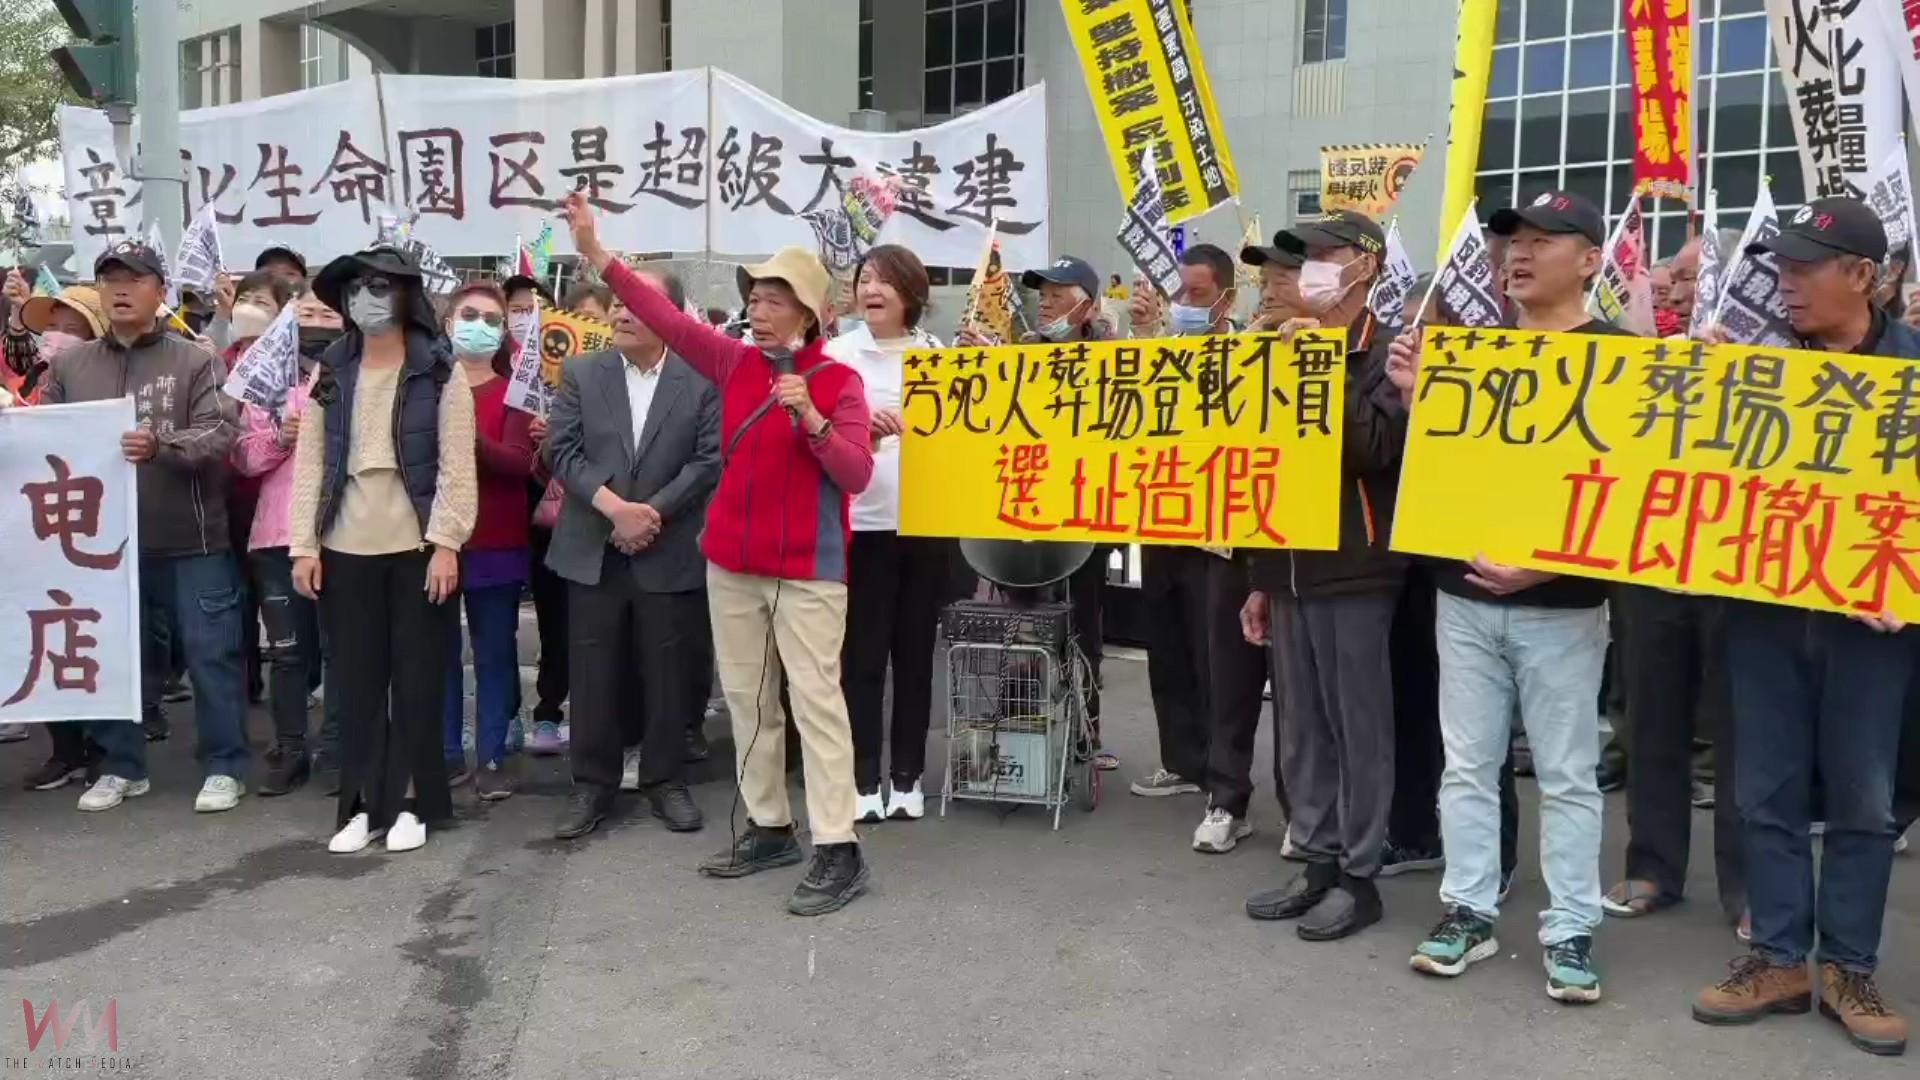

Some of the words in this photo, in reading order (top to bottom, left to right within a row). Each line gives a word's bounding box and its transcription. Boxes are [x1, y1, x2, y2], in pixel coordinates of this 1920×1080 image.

[903, 332, 1342, 440] 芳苑火葬場登載不實
[994, 443, 1287, 545] 選址造假
[1532, 459, 1920, 613] 立即撤案
